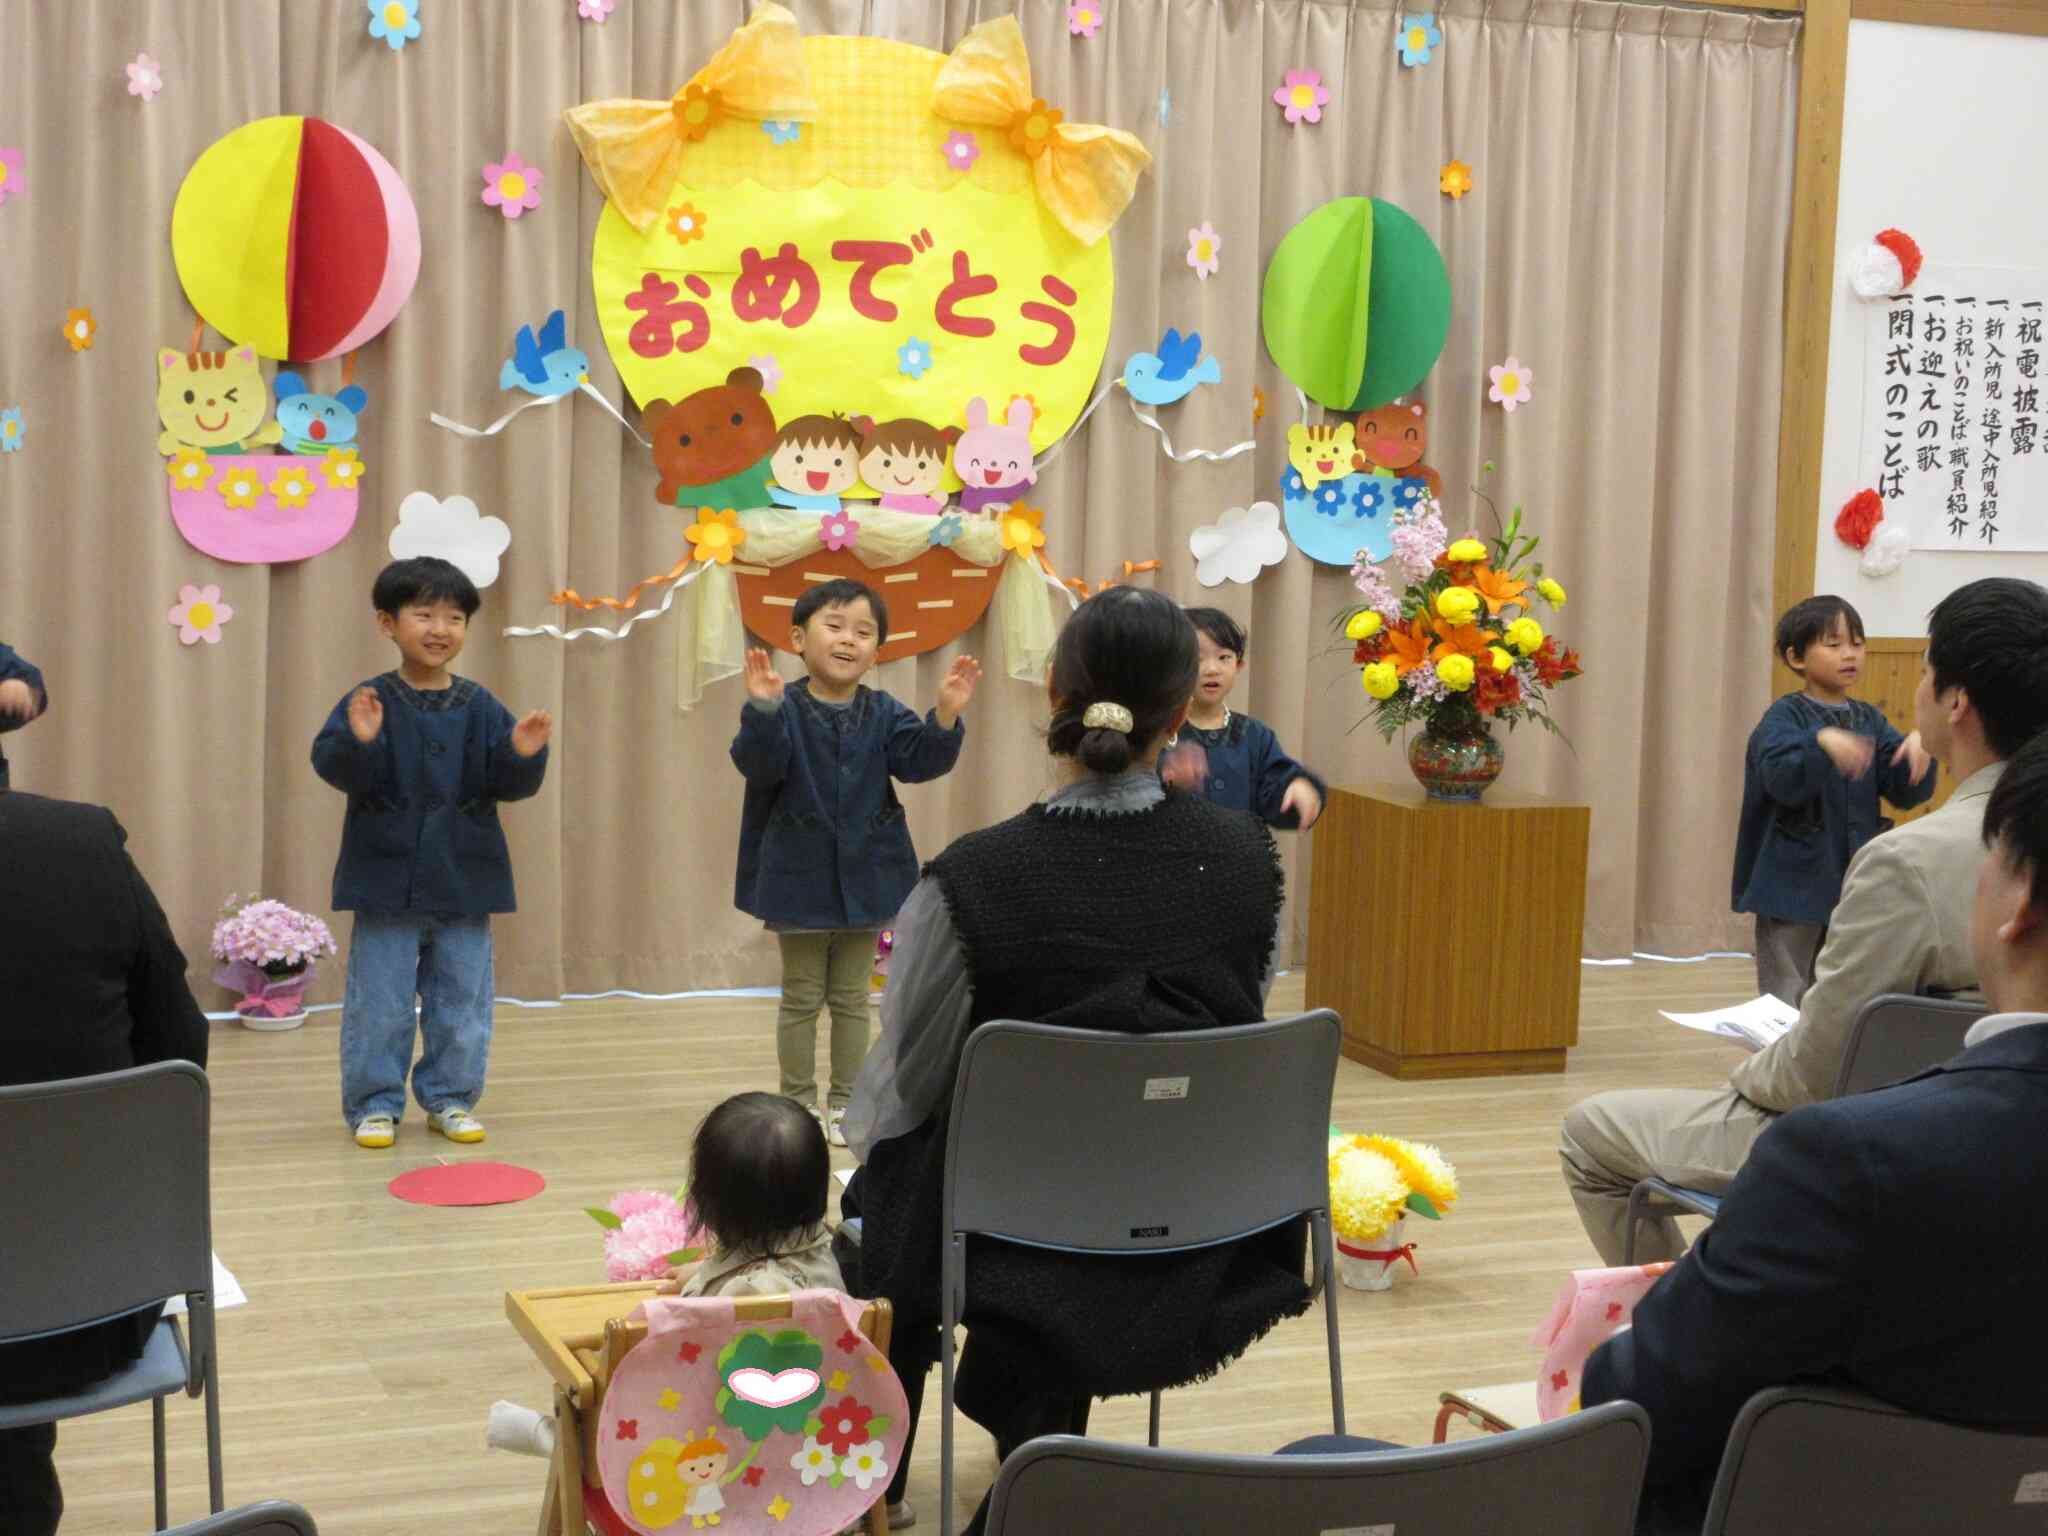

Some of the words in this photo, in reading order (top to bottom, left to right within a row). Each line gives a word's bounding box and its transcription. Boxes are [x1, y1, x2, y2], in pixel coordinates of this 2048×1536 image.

[624, 228, 1077, 366] おめでとう
